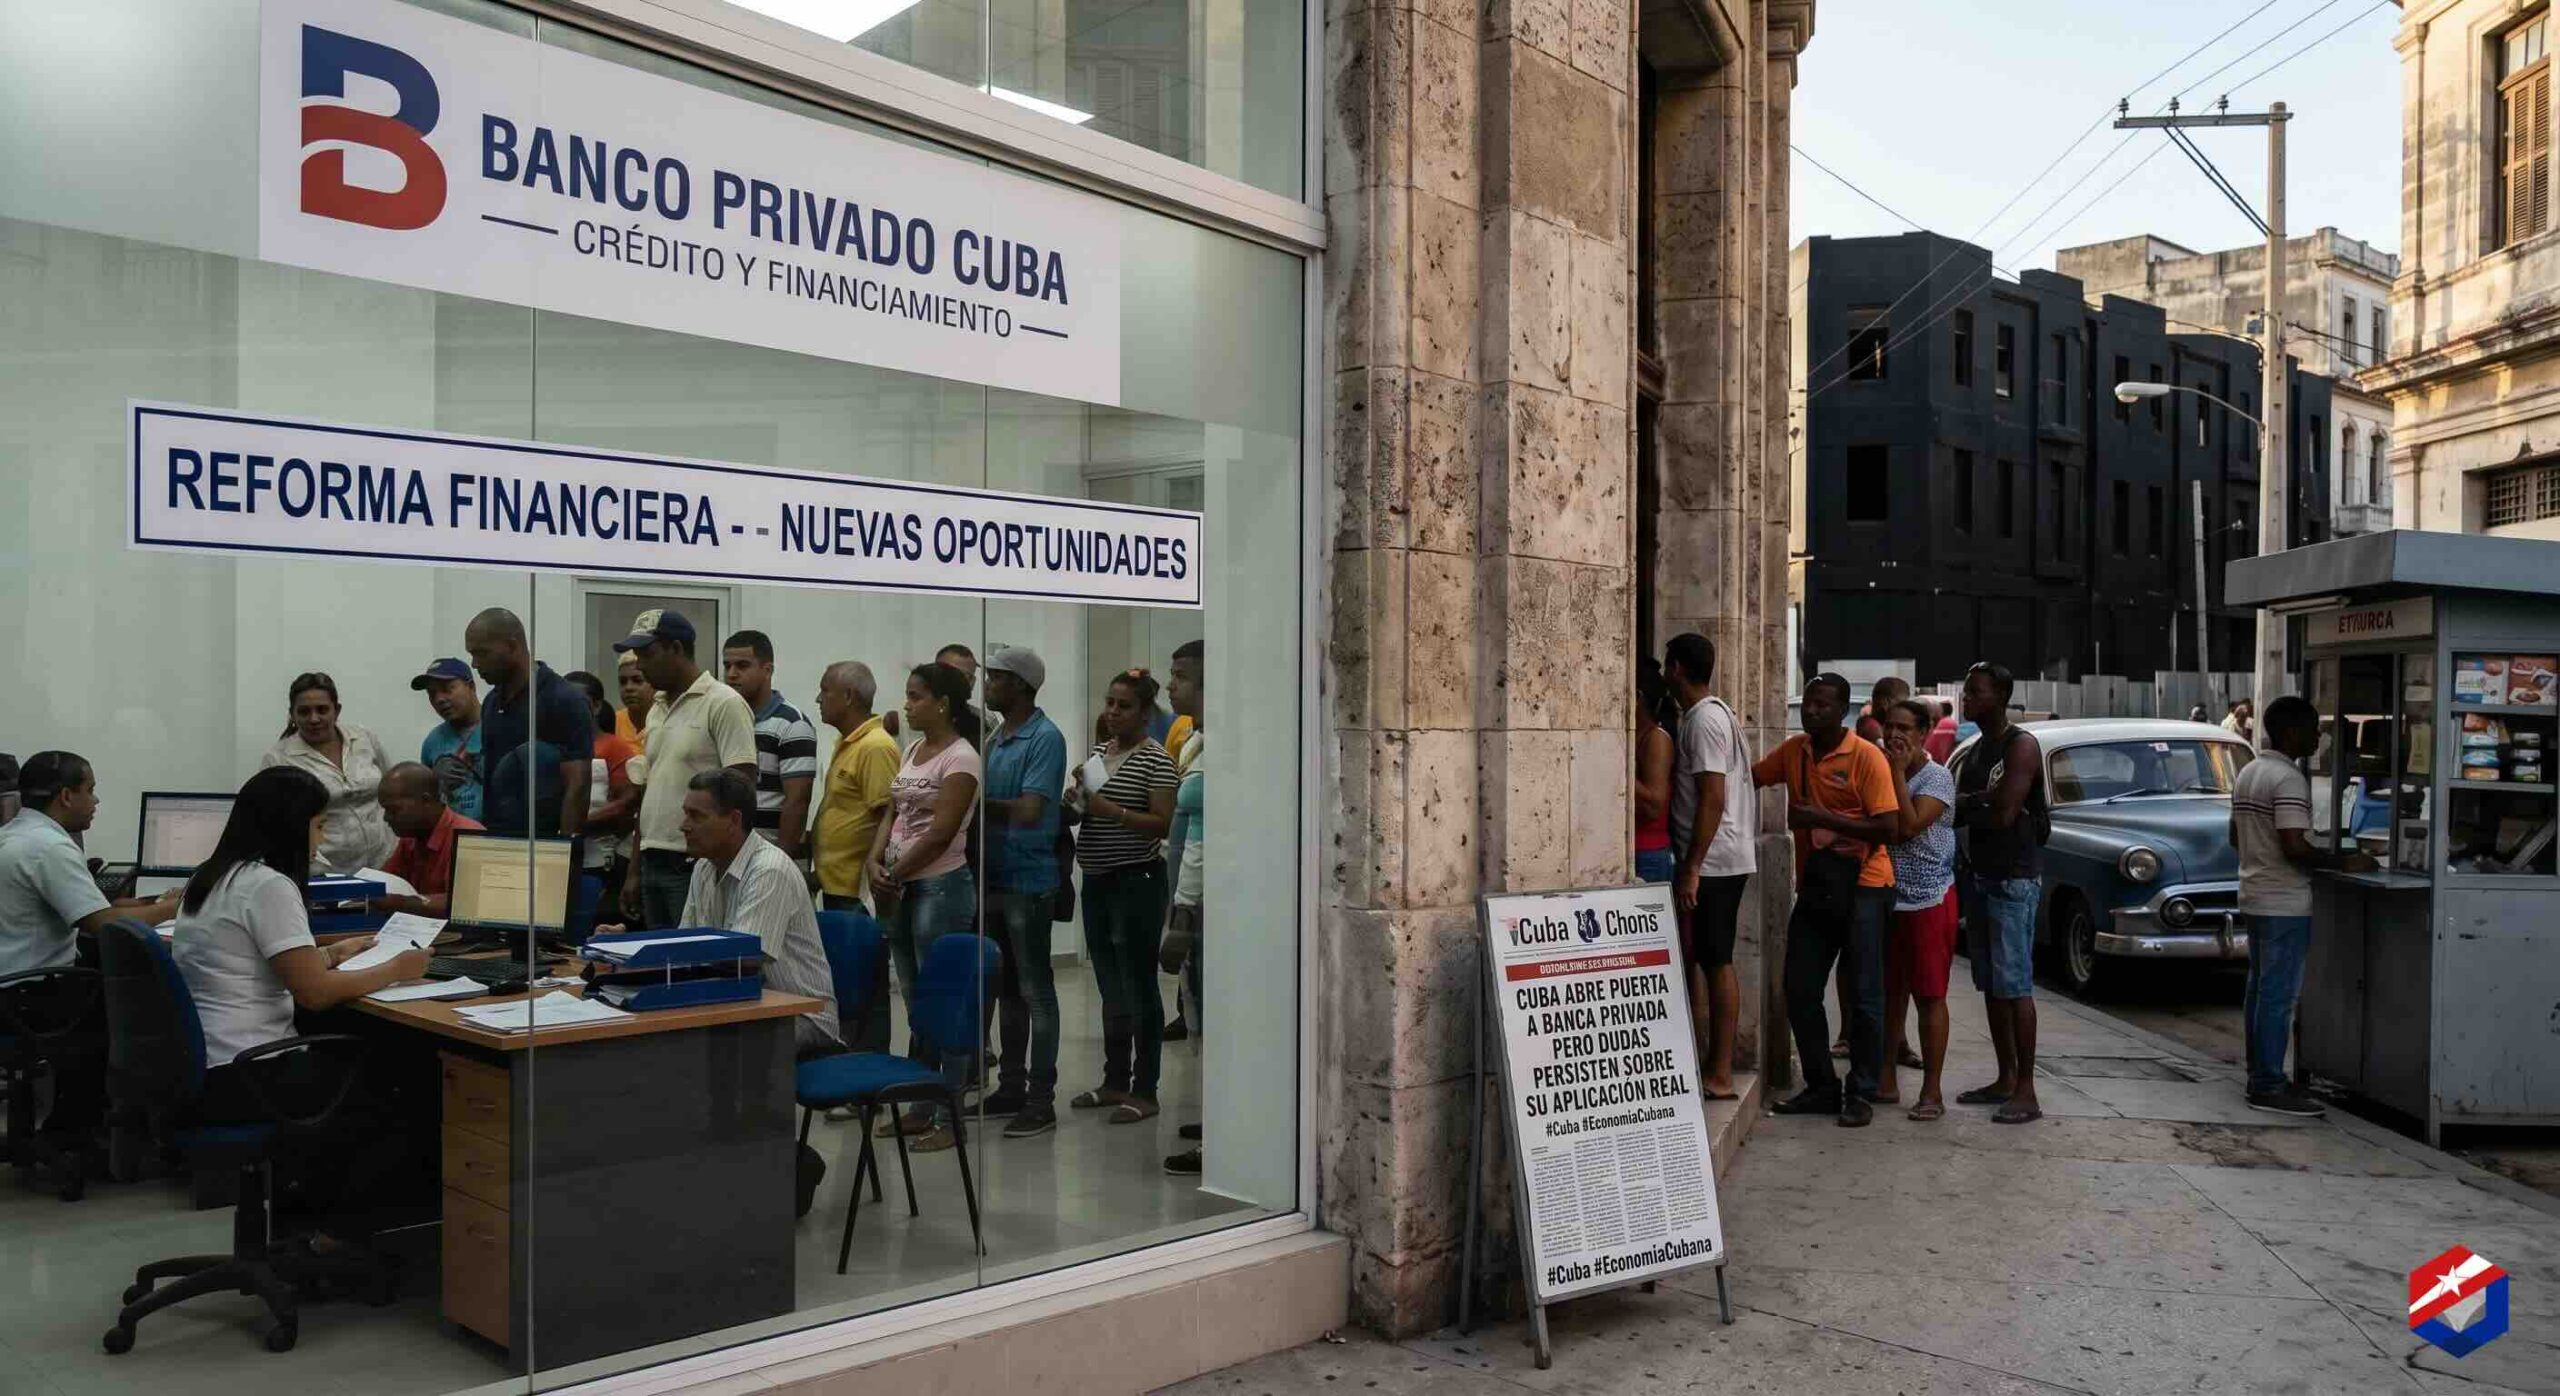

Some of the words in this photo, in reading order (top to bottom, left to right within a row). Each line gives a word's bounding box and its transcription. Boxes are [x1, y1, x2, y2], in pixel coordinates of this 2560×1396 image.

[482, 114, 691, 220] BANCO
[713, 169, 935, 275] PRIVADO
[953, 228, 1068, 305] CUBA
[573, 219, 725, 281] CRÉDITO
[735, 256, 757, 287] Y
[768, 260, 1013, 338] FINANCIAMIENTO
[168, 447, 434, 527] REFORMA
[450, 473, 720, 546] FINANCIERA
[781, 503, 922, 561] NUEVAS
[933, 516, 1188, 580] OPORTUNIDADES
[1519, 915, 1569, 944] Cuba
[1606, 910, 1659, 936] Chons
[1516, 985, 1560, 1010] CUBA
[1565, 980, 1604, 1004] ABRE
[1611, 974, 1669, 998] PUERTA
[1527, 1015, 1538, 1036] A
[1543, 1008, 1596, 1034] BANCA
[1601, 999, 1668, 1026] PRIVADA
[1553, 1035, 1594, 1059] PERO
[1599, 1027, 1651, 1052] DUDAS
[1534, 1057, 1619, 1089] PERSISTEN
[1624, 1049, 1674, 1077] SOBRE
[1526, 1094, 1548, 1117] SU
[1553, 1077, 1646, 1113] APLICACIÓN
[1651, 1074, 1690, 1098] REAL
[1546, 1117, 1579, 1137] #Cuba
[1548, 1262, 1591, 1286] #Cuba
